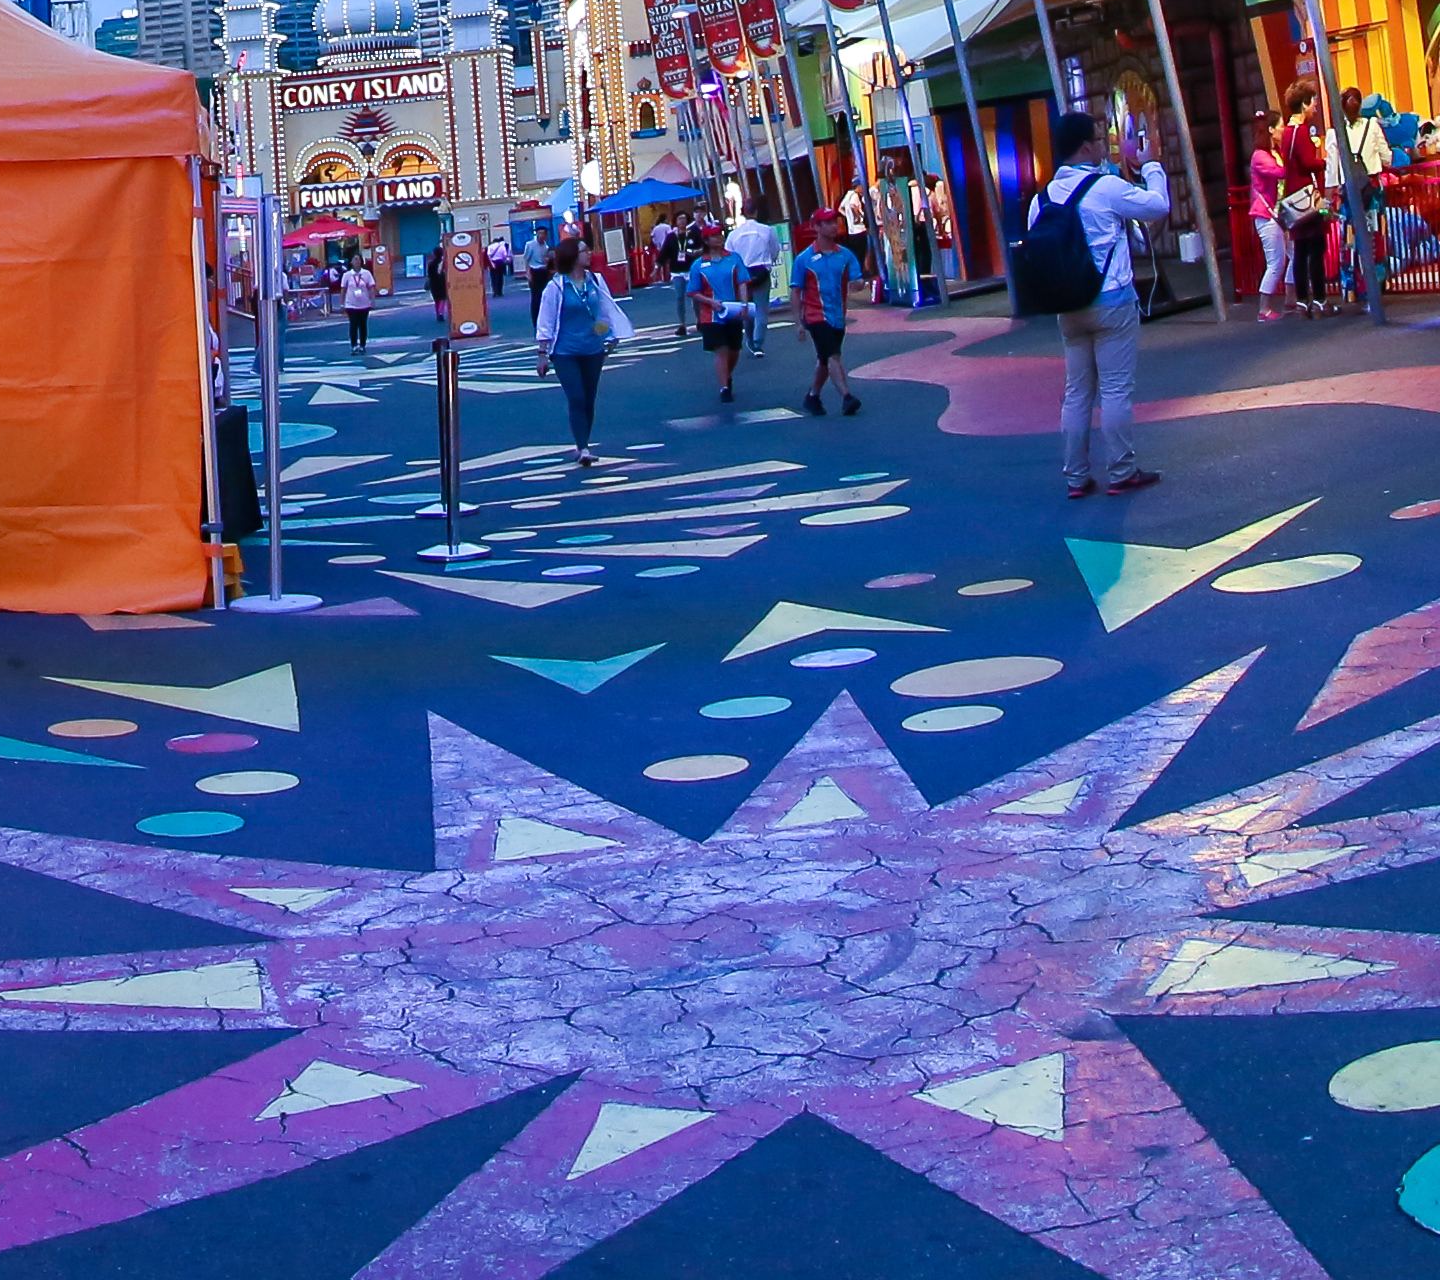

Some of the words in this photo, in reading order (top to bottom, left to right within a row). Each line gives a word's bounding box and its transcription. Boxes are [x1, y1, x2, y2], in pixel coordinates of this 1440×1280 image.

[701, 0, 734, 16] WIN
[652, 20, 679, 35] FUN
[656, 45, 685, 59] ONE!
[283, 81, 356, 108] CONEY
[363, 72, 445, 100] ISLAND
[300, 187, 362, 208] FUNNY
[383, 180, 436, 202] LAND
